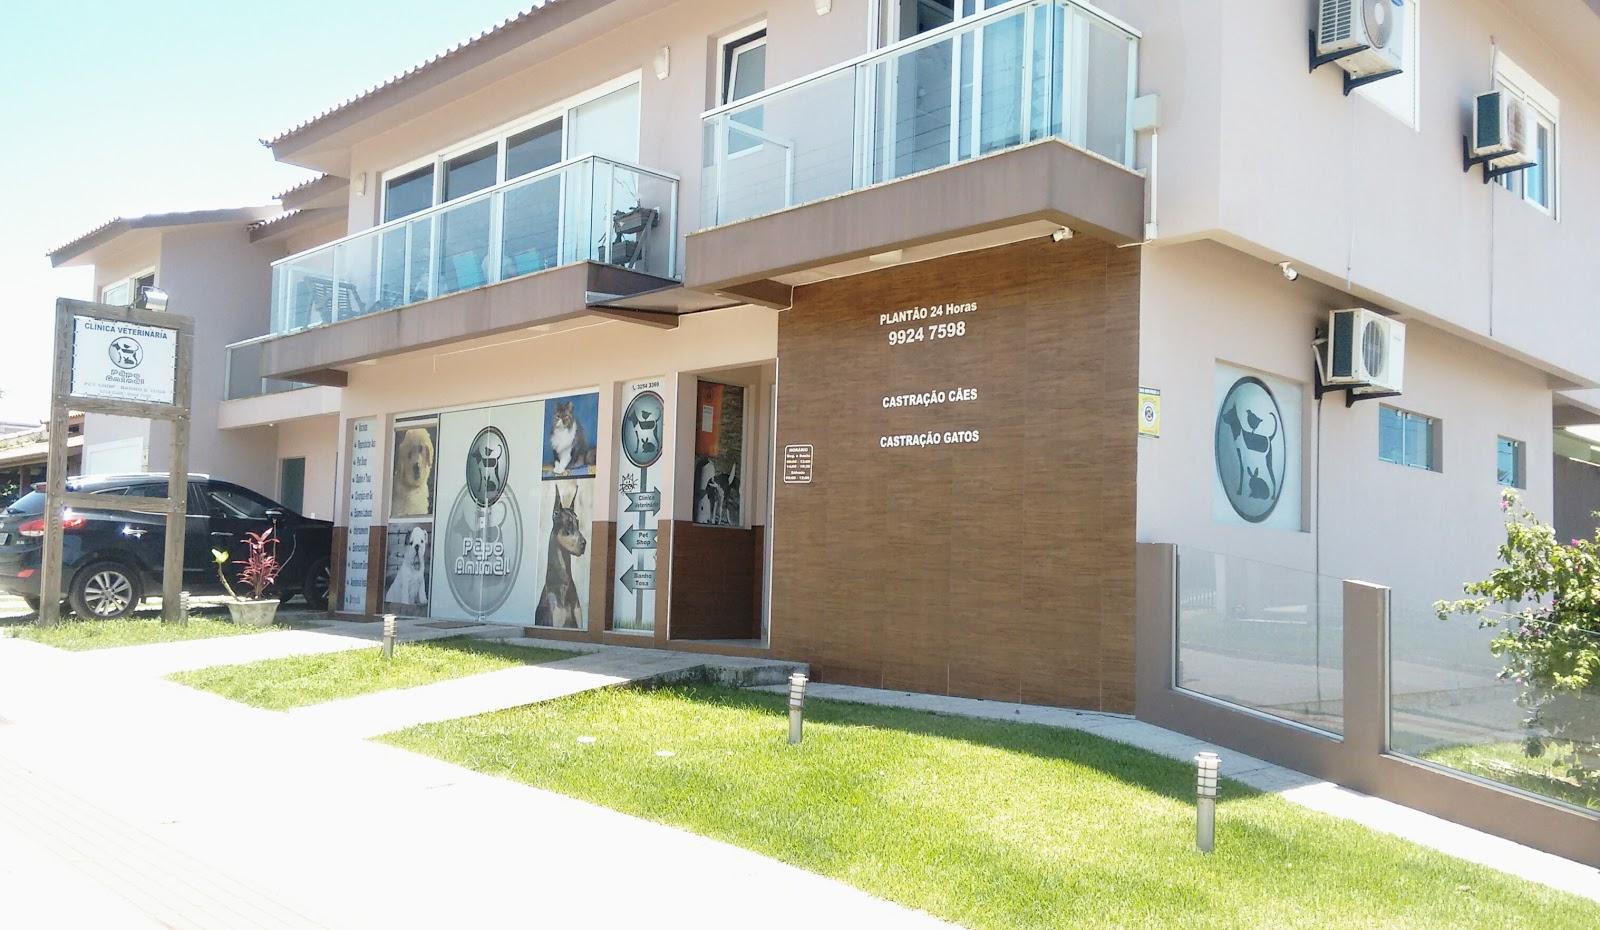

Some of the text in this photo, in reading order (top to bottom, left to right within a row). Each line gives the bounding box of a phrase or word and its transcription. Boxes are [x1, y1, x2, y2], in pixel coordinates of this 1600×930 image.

[879, 302, 978, 326] PLANTÃO 24 Horas
[888, 321, 966, 346] 9924 7598
[882, 387, 978, 408] CASTRAÇÃO CÃES
[880, 430, 980, 448] CASTRAÇÃO GATOS
[462, 537, 504, 561] Papo
[636, 539, 651, 547] Shop
[454, 556, 511, 577] Animal
